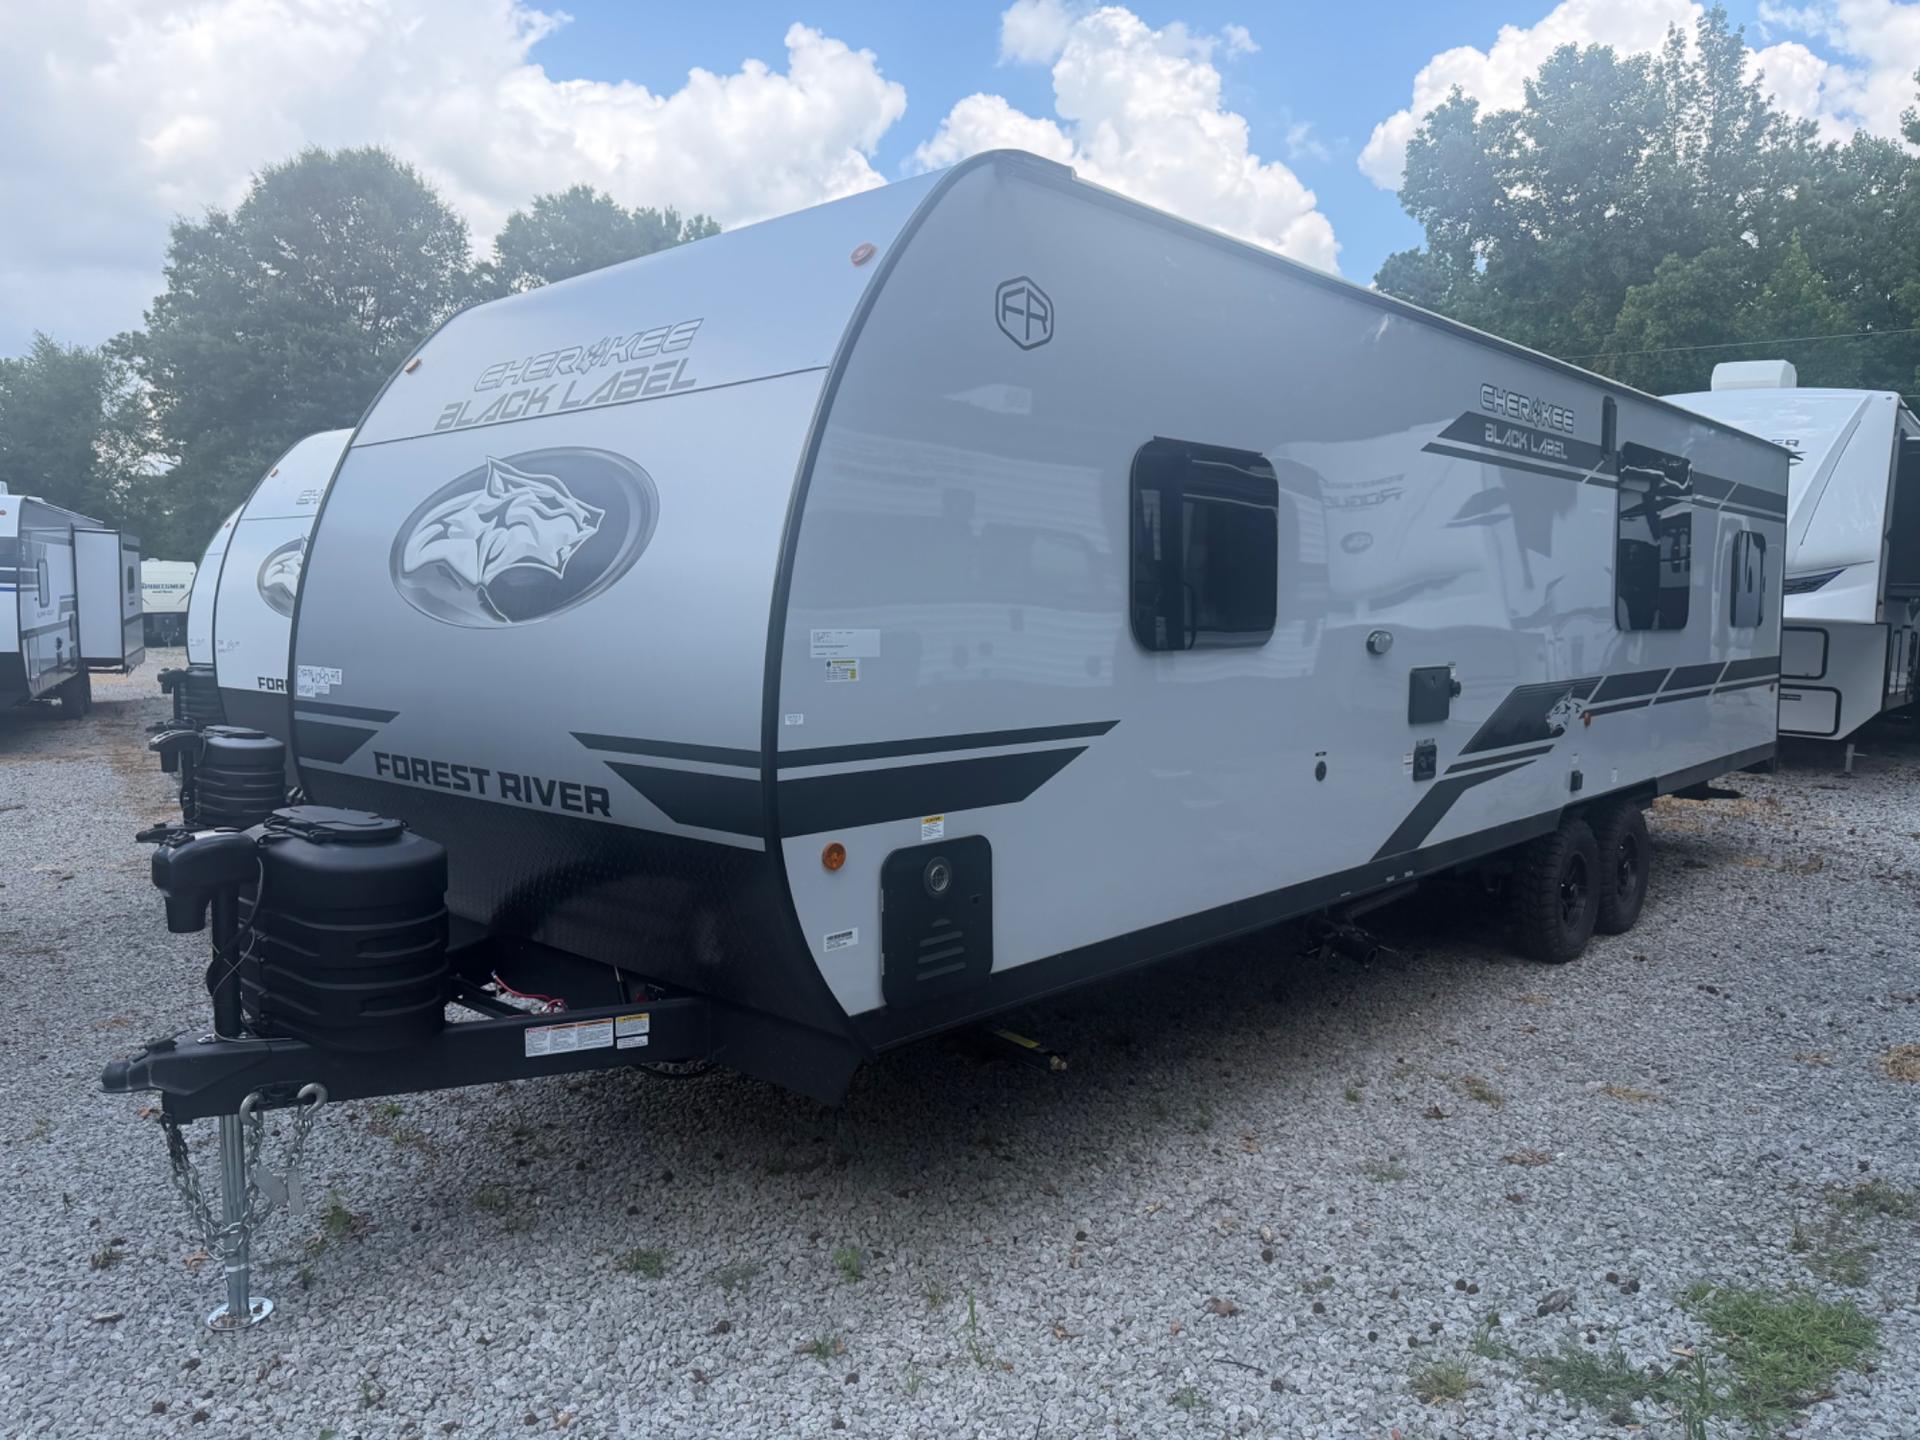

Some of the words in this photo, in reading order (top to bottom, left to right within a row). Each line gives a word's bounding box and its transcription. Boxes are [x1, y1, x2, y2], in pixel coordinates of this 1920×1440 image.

[474, 317, 705, 392] CHEROKEE
[433, 382, 560, 431] BLACK
[558, 357, 697, 410] LABEL
[1480, 382, 1575, 434] CHEROKEE
[1485, 422, 1528, 451] BLACK
[1530, 433, 1568, 460] LABEL
[372, 751, 491, 795] FOREST
[497, 771, 613, 818] RIVER
